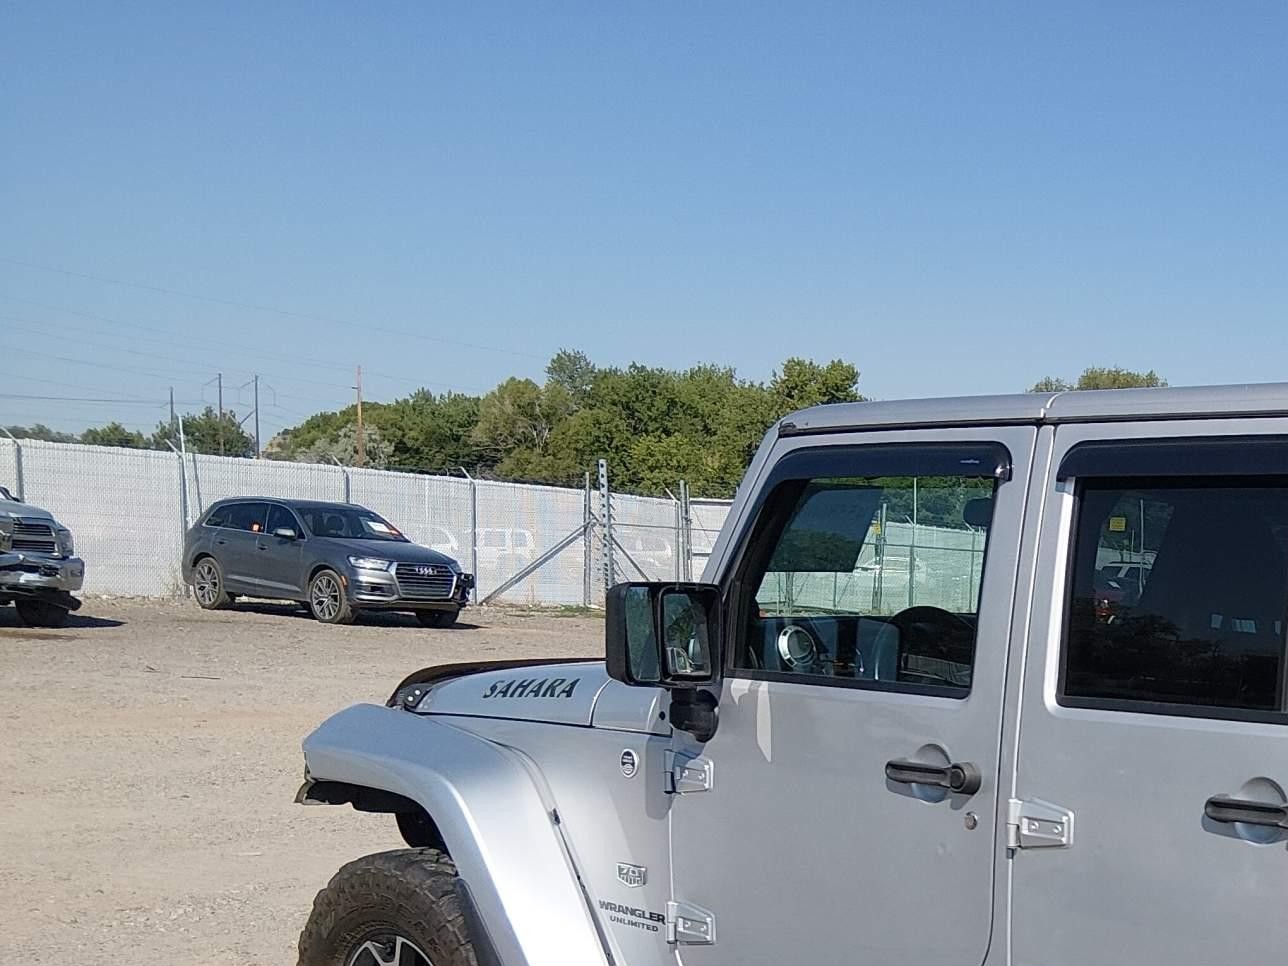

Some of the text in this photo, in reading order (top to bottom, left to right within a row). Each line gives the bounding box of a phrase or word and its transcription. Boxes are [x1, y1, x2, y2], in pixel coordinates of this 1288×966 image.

[482, 678, 580, 698] SAHARA
[599, 900, 666, 926] WRANGLER
[610, 915, 659, 932] UNLIMITED
